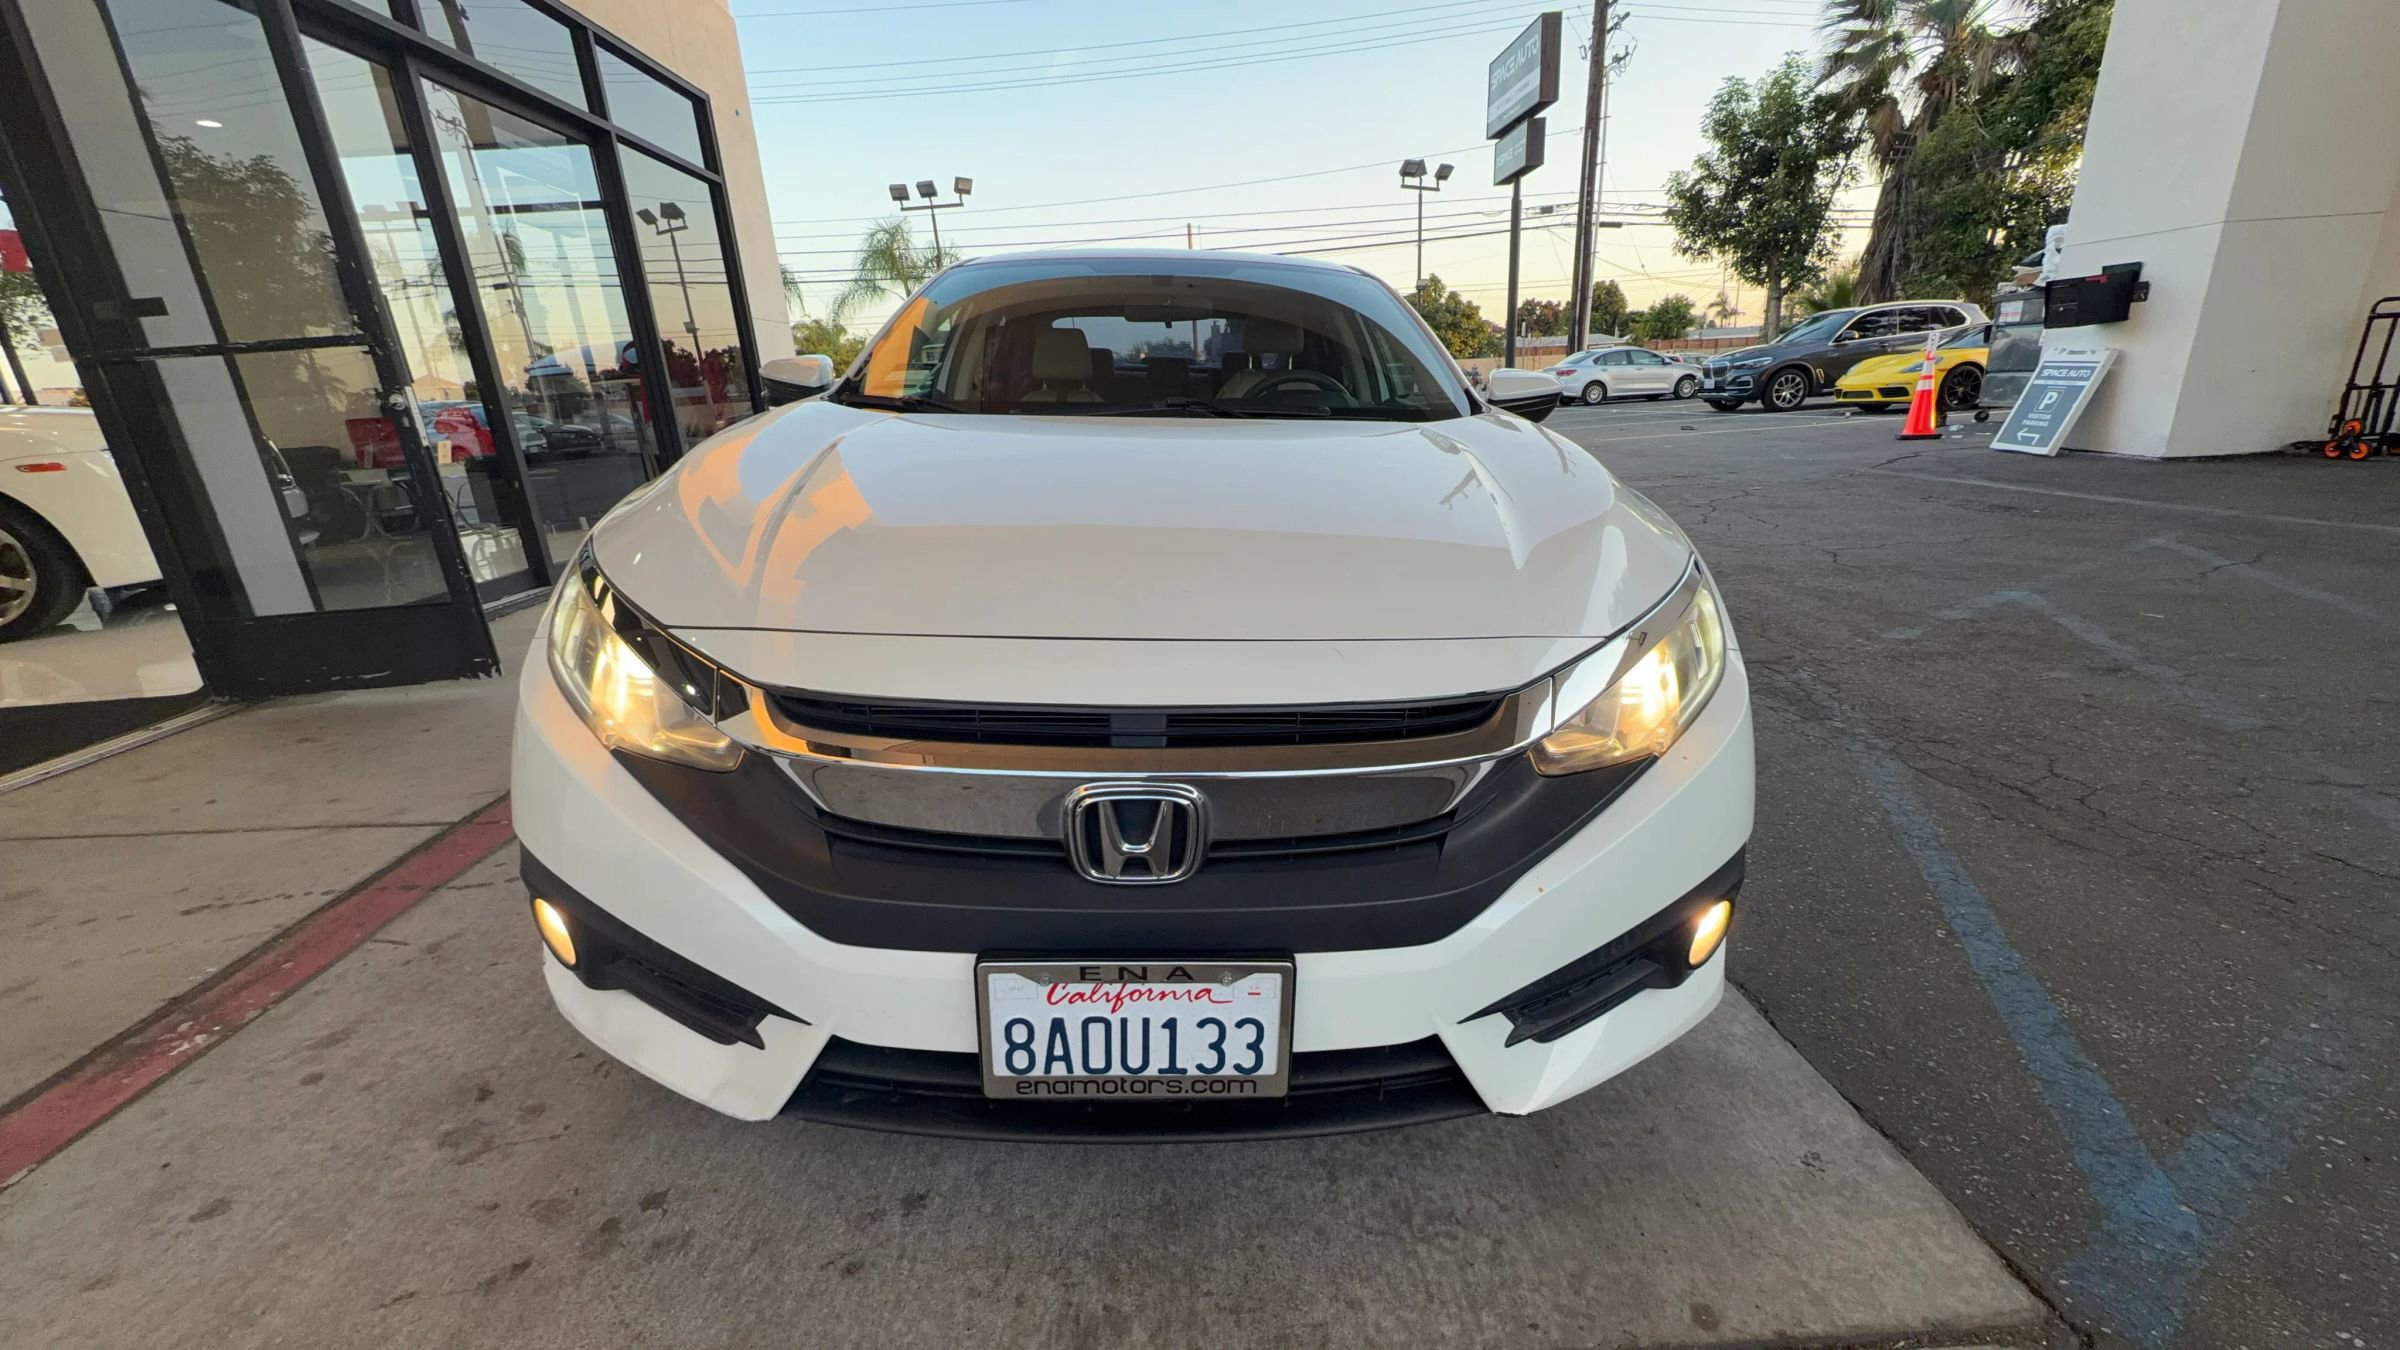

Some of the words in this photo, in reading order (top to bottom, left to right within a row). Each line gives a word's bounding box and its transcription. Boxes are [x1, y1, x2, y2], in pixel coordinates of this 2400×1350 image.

[1491, 56, 1515, 91] SPACE
[1515, 34, 1539, 72] AUTO
[2041, 368, 2069, 377] SPACE
[2067, 369, 2092, 378] AUTO
[2038, 391, 2058, 410] P
[2022, 419, 2049, 427] PARKING
[1045, 982, 1233, 1015] California
[1015, 1076, 1258, 1096] enamotors.com
